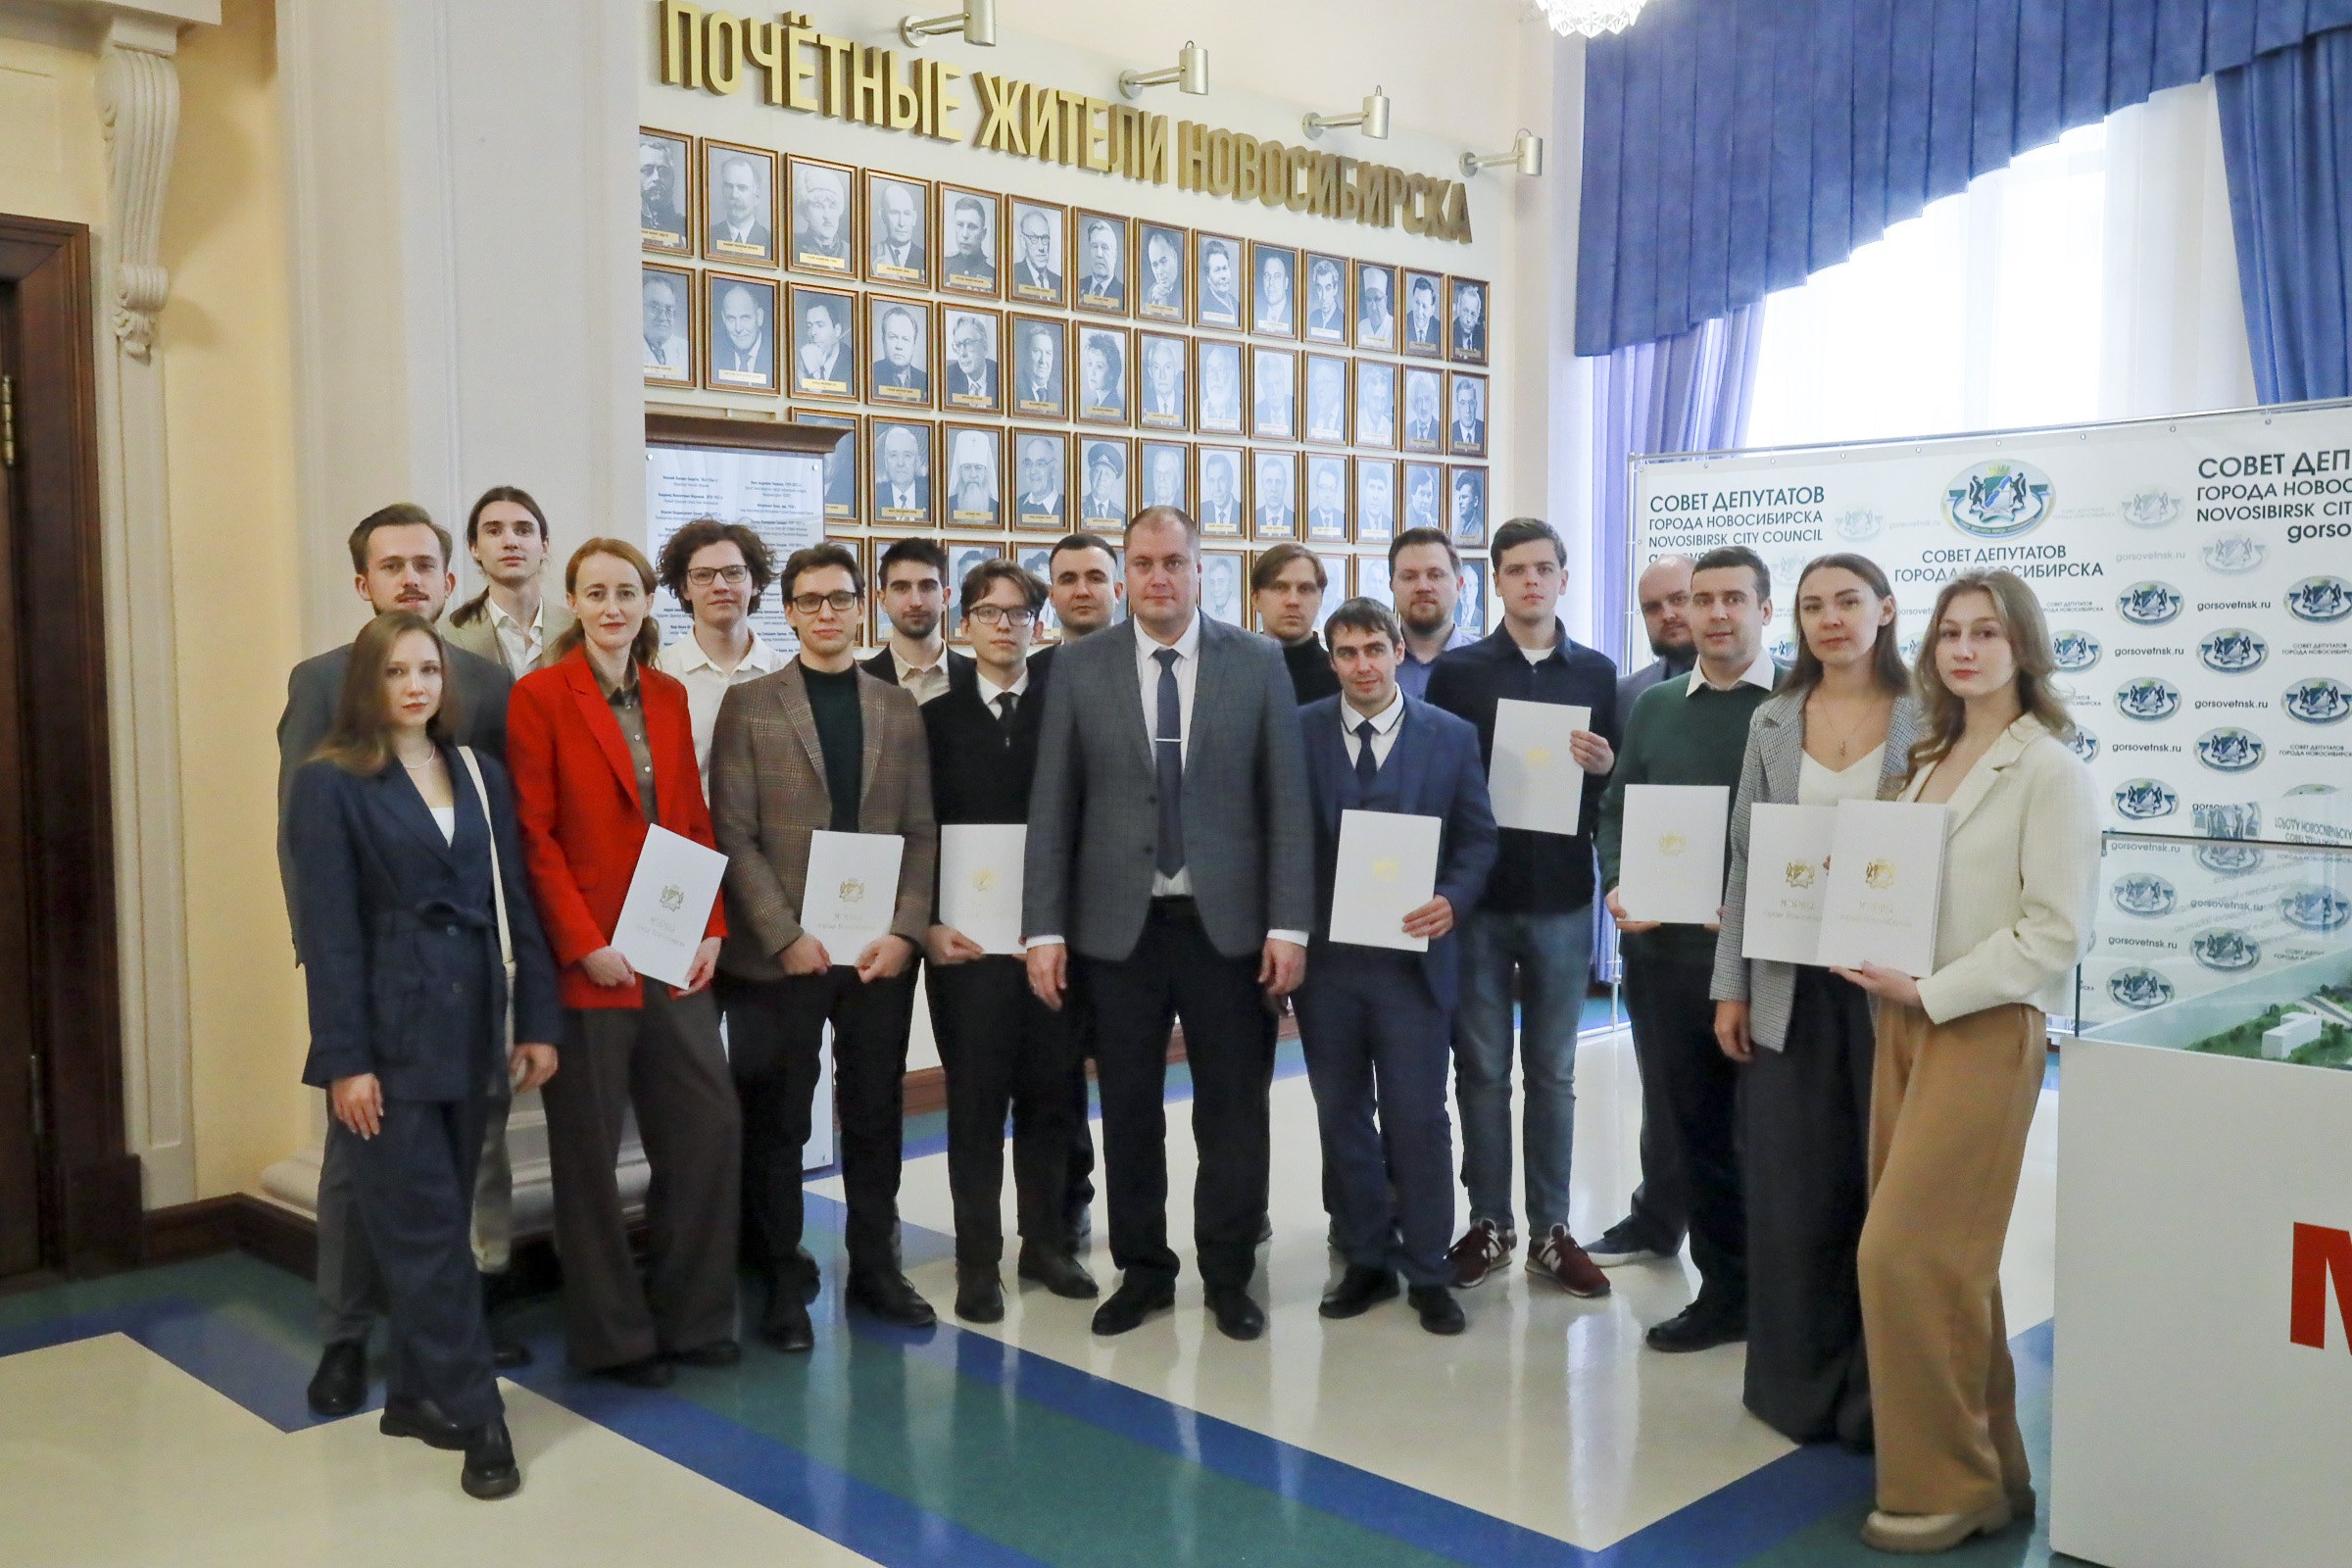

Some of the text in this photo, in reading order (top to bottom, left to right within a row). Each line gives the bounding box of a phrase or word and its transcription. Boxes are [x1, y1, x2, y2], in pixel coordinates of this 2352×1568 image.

[661, 0, 1473, 245] ПОЧЁТНЫЕ ЖИТЕЛИ НОВОСИБИРСКА
[2198, 449, 2351, 479] СОВЕТ ДЕП
[1650, 486, 1825, 514] СОВЕТ ДЕПУТАТОВ
[2197, 483, 2278, 501] ГОРОДА
[1649, 510, 1823, 531] ГОРОДА НОВОСИБИРСКА
[2197, 503, 2315, 522] NOVOSIBIRSK
[1648, 529, 1823, 548] NOVOSIBIRSK CITY COUNCIL
[2287, 523, 2352, 544] gorso
[1922, 545, 2067, 564] СОВЕТ ДЕПУТАТОВ
[2197, 600, 2271, 612] gorsovetnsk.ru
[2114, 646, 2184, 659] gorsovetnsk.ru
[2194, 698, 2269, 710] gorsovetnsk.ru
[2112, 742, 2181, 754] gorsovetnsk.ru
[2111, 841, 2180, 853] gorsovetnsk.ru
[2190, 898, 2264, 911] gorsovetnsk.ru
[2108, 935, 2178, 950] gorsovetnsk.ru
